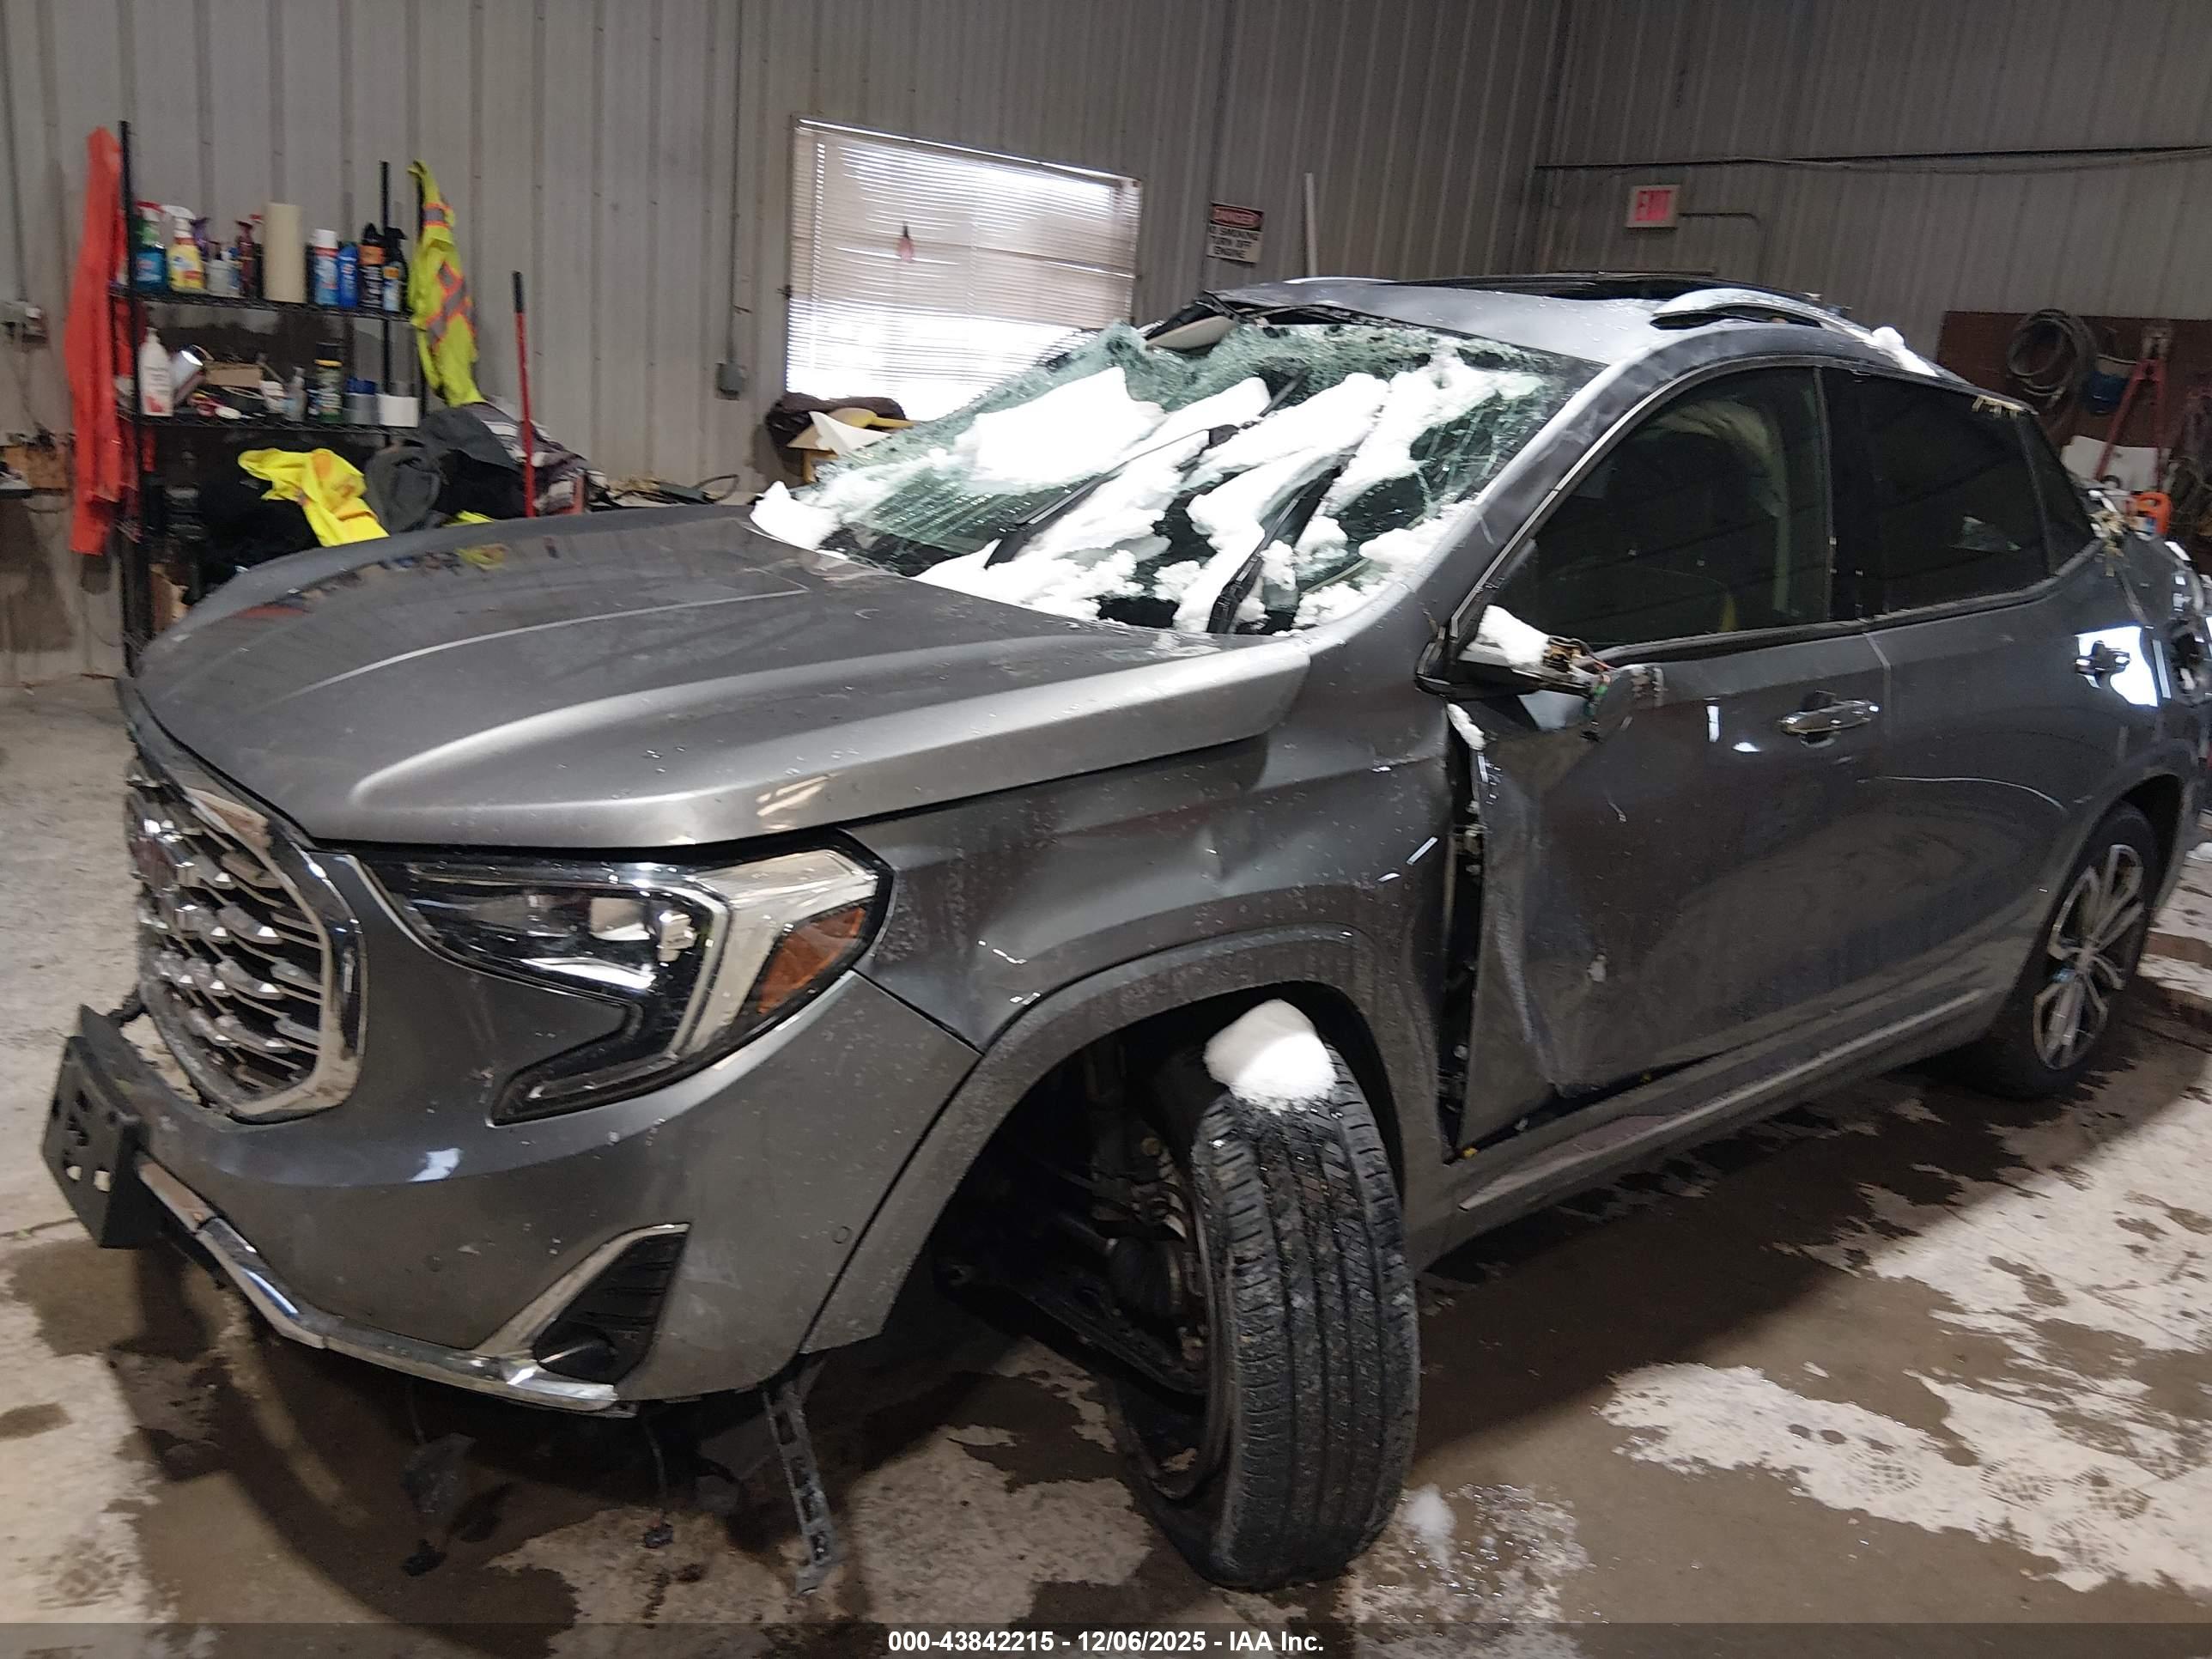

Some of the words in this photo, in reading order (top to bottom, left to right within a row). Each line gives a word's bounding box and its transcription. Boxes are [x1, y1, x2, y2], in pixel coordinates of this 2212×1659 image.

[1219, 228, 1259, 241] SMOKING
[1210, 235, 1232, 246] TURN
[1236, 240, 1253, 249] OFF
[1213, 246, 1246, 258] ENGINE
